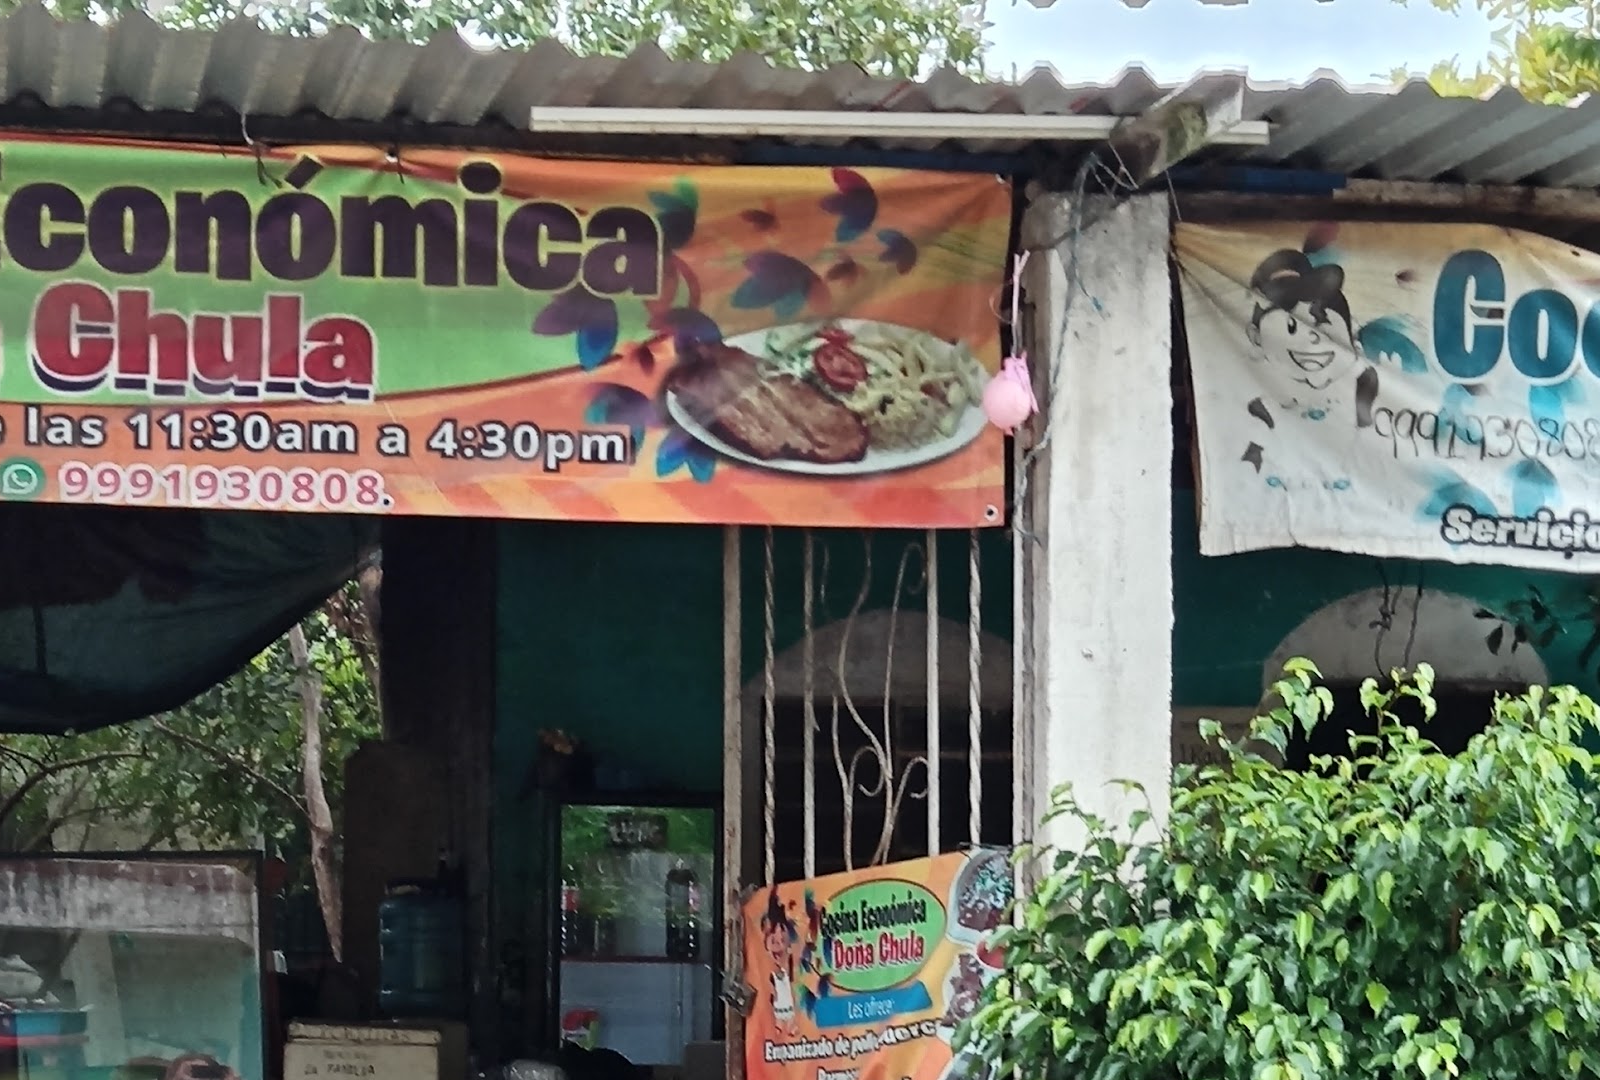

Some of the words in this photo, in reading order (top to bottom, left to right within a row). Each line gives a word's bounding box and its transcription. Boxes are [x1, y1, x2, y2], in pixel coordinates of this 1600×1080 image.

[30, 282, 379, 402] Chula
[24, 405, 107, 449] las
[128, 410, 358, 455] 11:30am
[378, 421, 410, 457] a
[429, 420, 632, 473] 4:30pm
[832, 934, 876, 974] Doña
[877, 928, 926, 968] Chula
[763, 1033, 836, 1066] Empanizado
